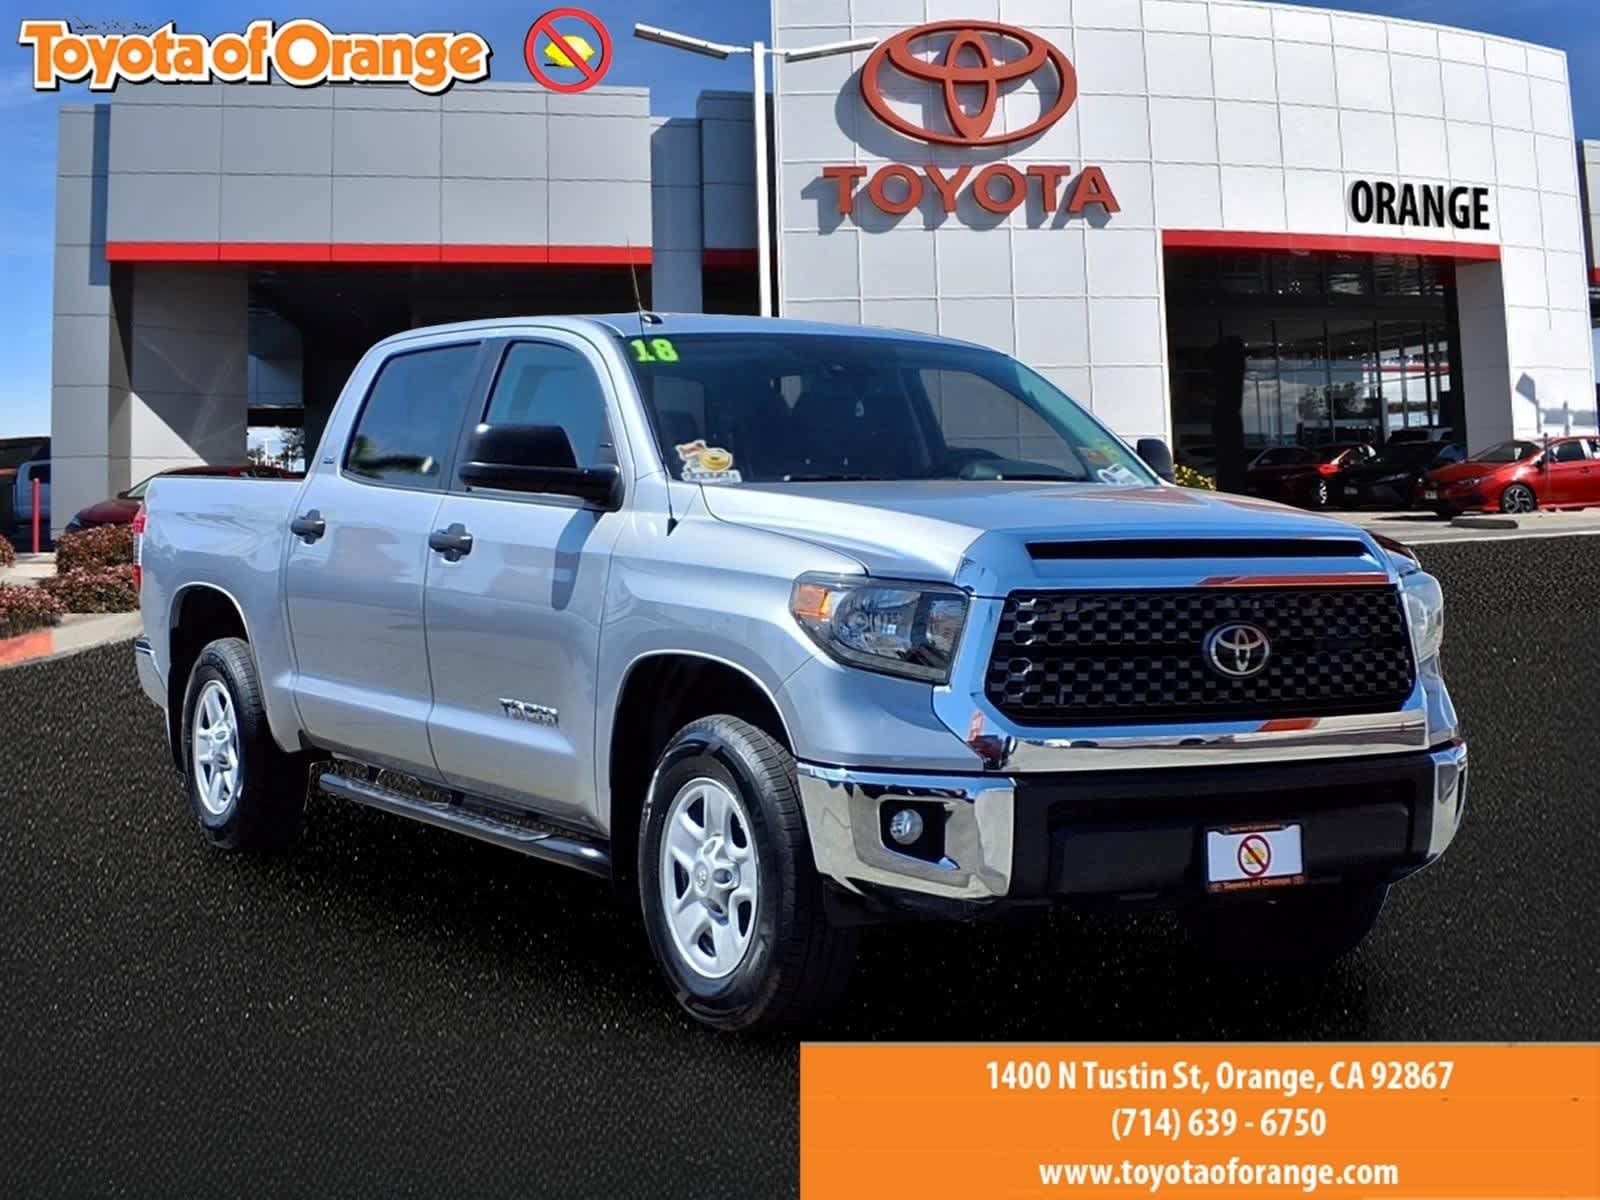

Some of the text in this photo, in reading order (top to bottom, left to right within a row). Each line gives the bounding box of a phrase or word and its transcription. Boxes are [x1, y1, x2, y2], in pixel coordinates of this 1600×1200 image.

[823, 164, 1120, 215] TOYOTA
[1350, 180, 1491, 231] ORANGE
[631, 338, 679, 362] 18
